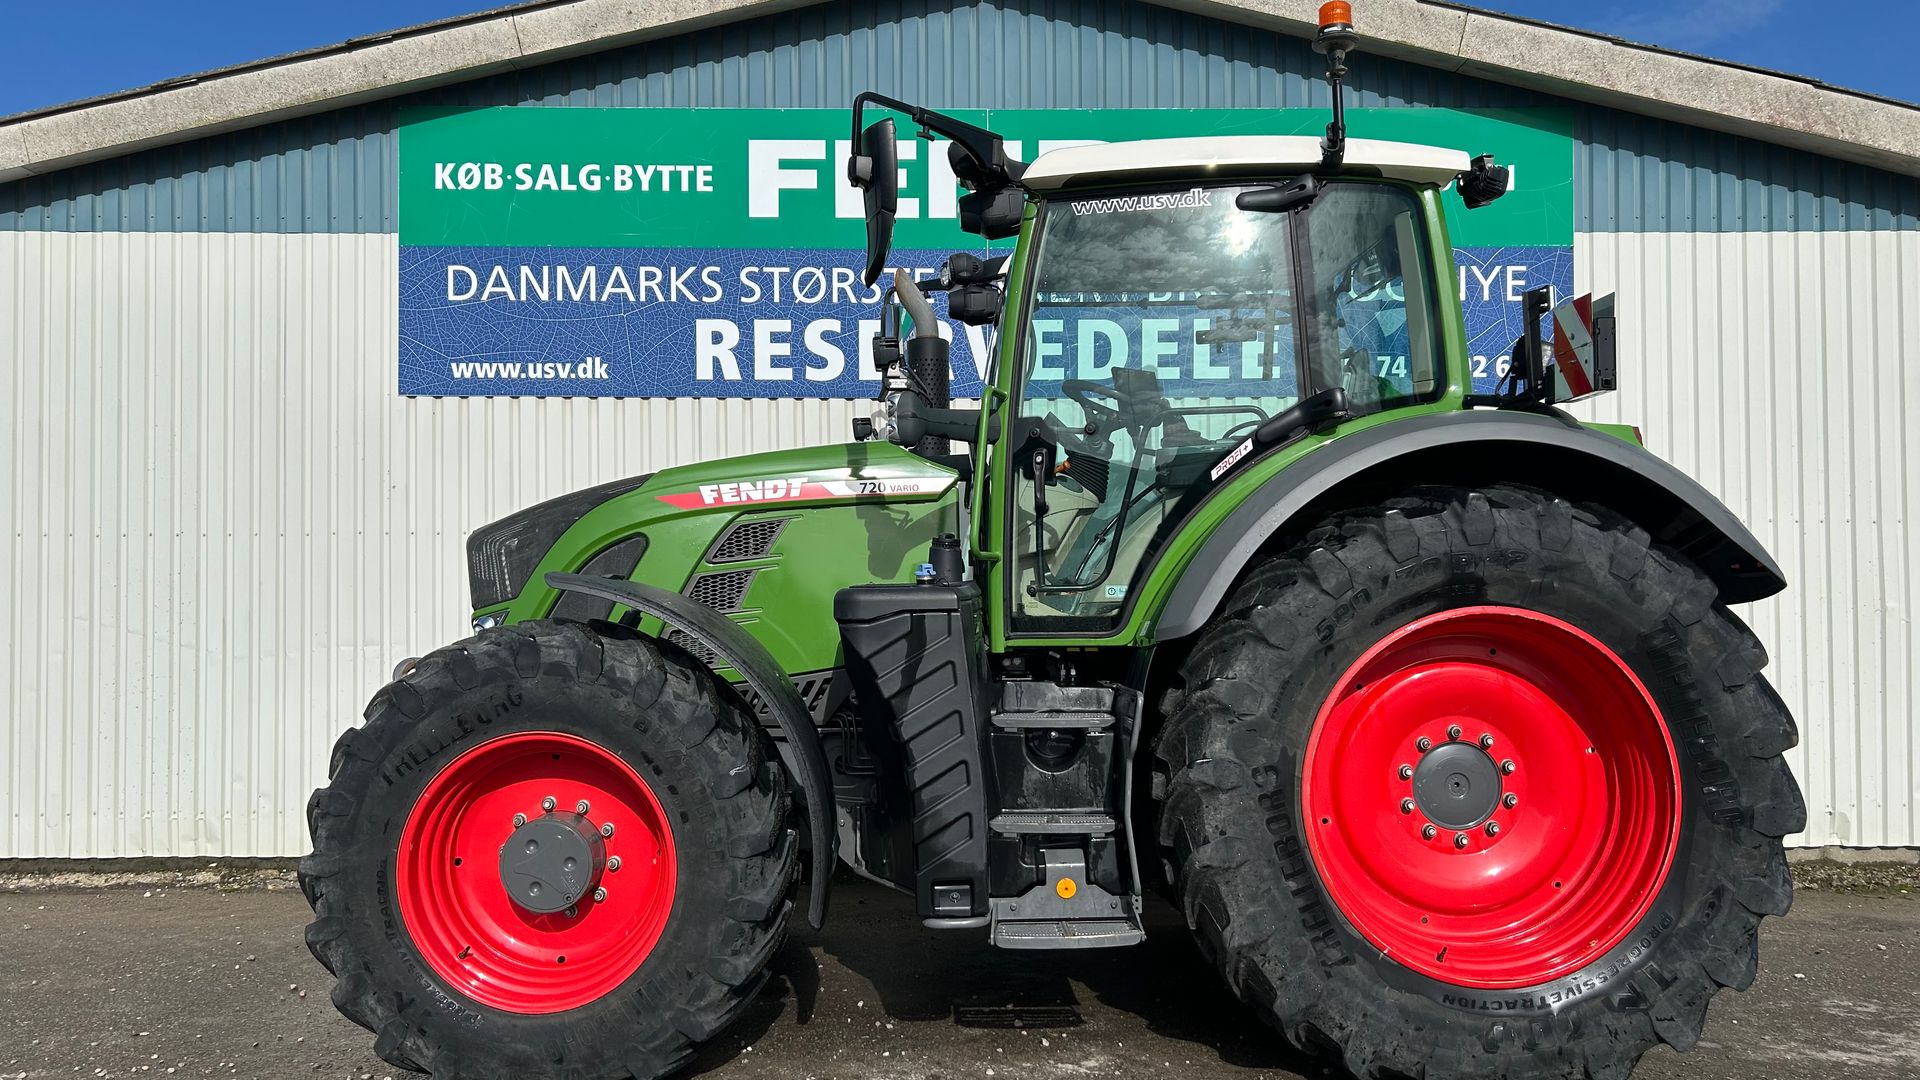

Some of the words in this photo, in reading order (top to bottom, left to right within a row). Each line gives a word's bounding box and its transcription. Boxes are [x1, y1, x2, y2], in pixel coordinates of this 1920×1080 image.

[1072, 189, 1212, 216] www.usv.dk
[447, 265, 724, 303] DANMARKS
[450, 357, 609, 380] www.usv.dk
[1376, 355, 1408, 378] 74
[1469, 355, 1488, 378] 2
[698, 477, 809, 505] FENDT
[859, 481, 886, 494] 720
[889, 484, 920, 493] VARIO
